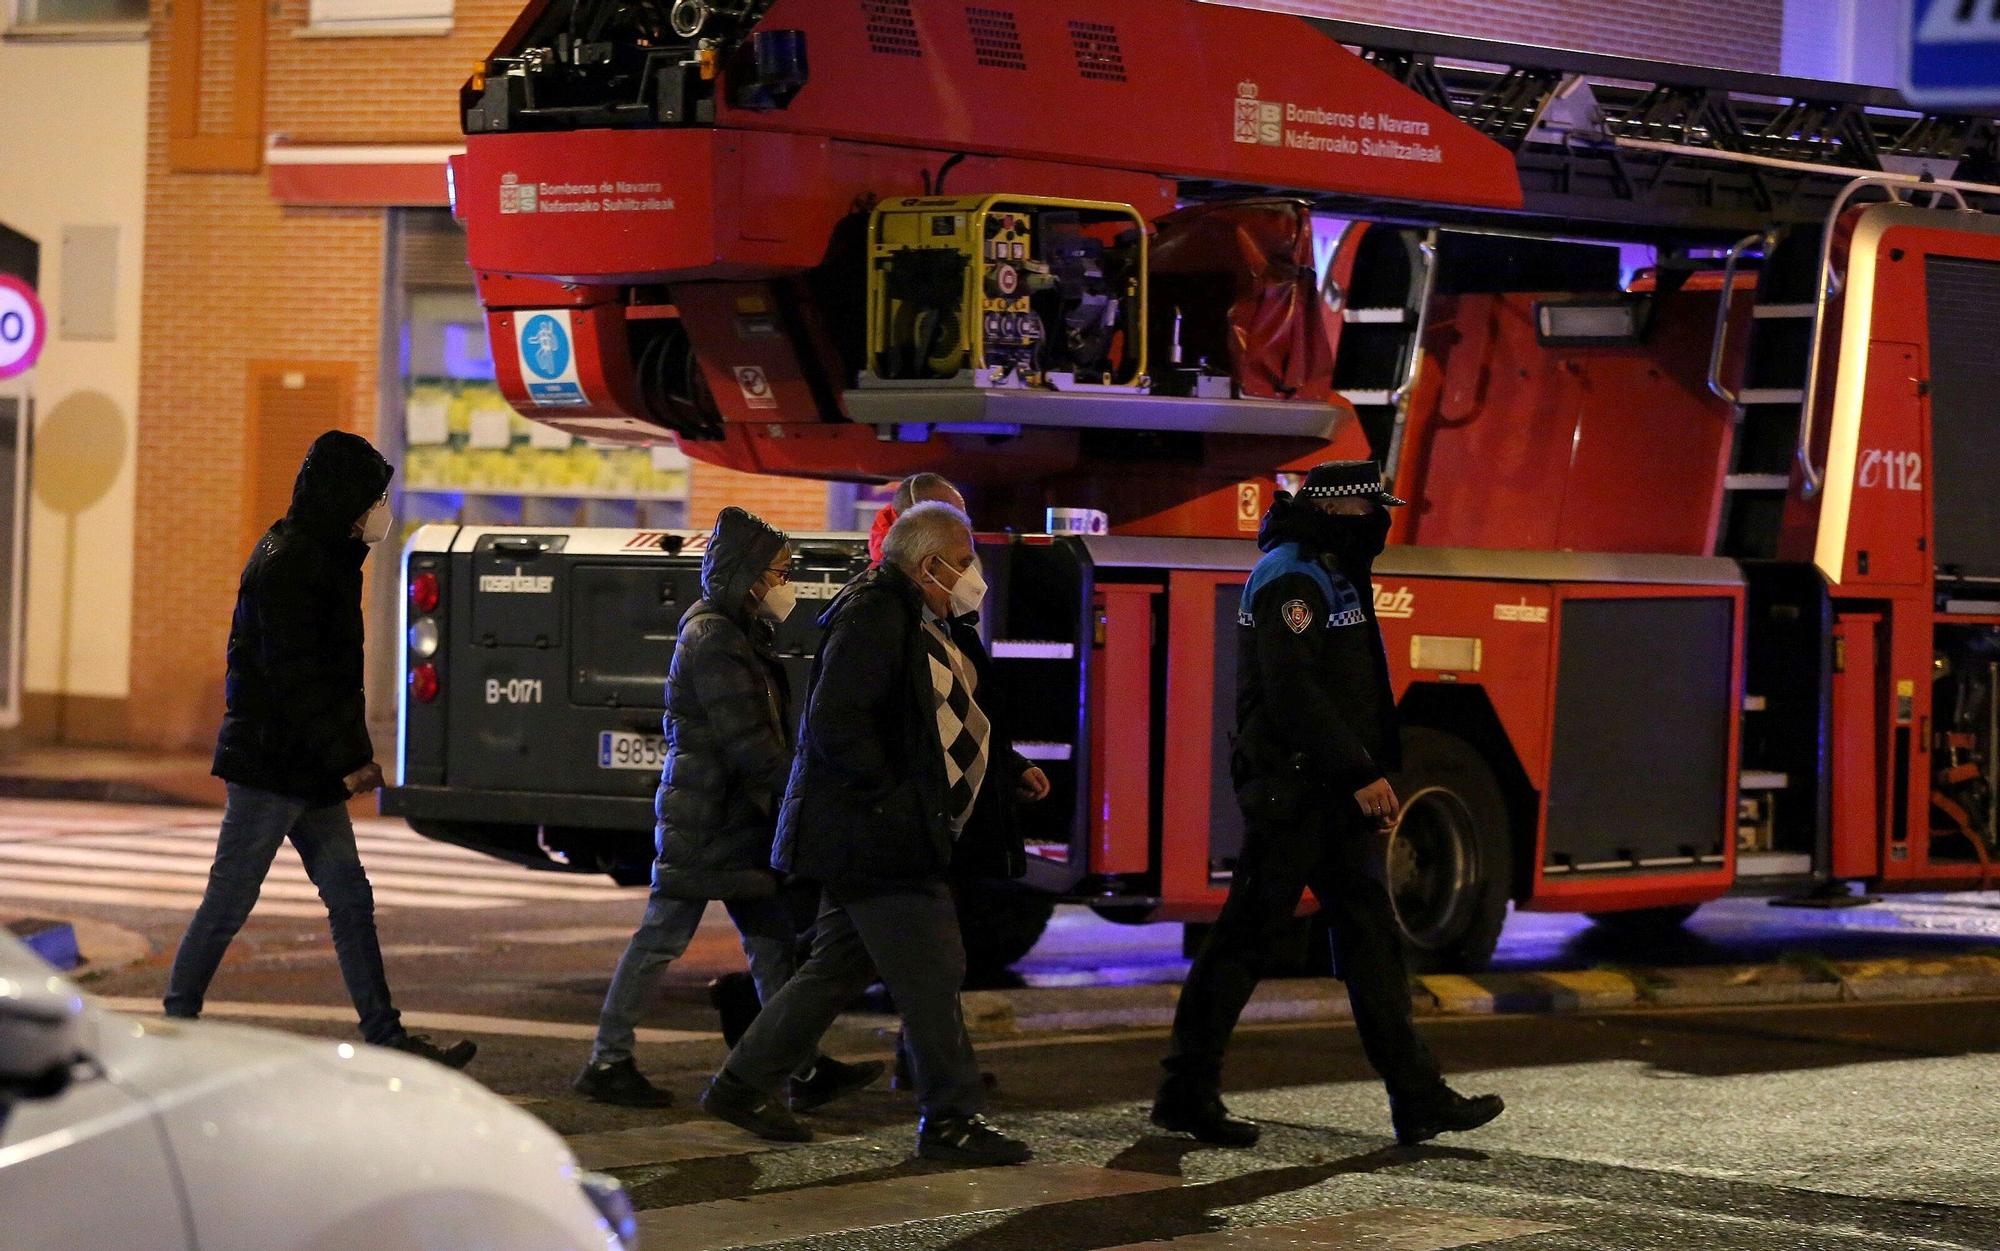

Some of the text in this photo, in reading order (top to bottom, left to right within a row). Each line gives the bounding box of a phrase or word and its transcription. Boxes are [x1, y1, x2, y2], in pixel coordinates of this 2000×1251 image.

[1261, 104, 1281, 122] B
[1286, 104, 1430, 136] Bomberos de Navarra
[1260, 124, 1281, 142] S
[1285, 130, 1443, 163] Nafarroako Suhiltzaileak
[539, 181, 662, 195] Bomberos de Navarra
[539, 198, 674, 212] Nafarroako Suhiltzaileak
[1881, 450, 1922, 491] 112
[1371, 584, 1415, 616] etz
[485, 678, 543, 704] B-0171
